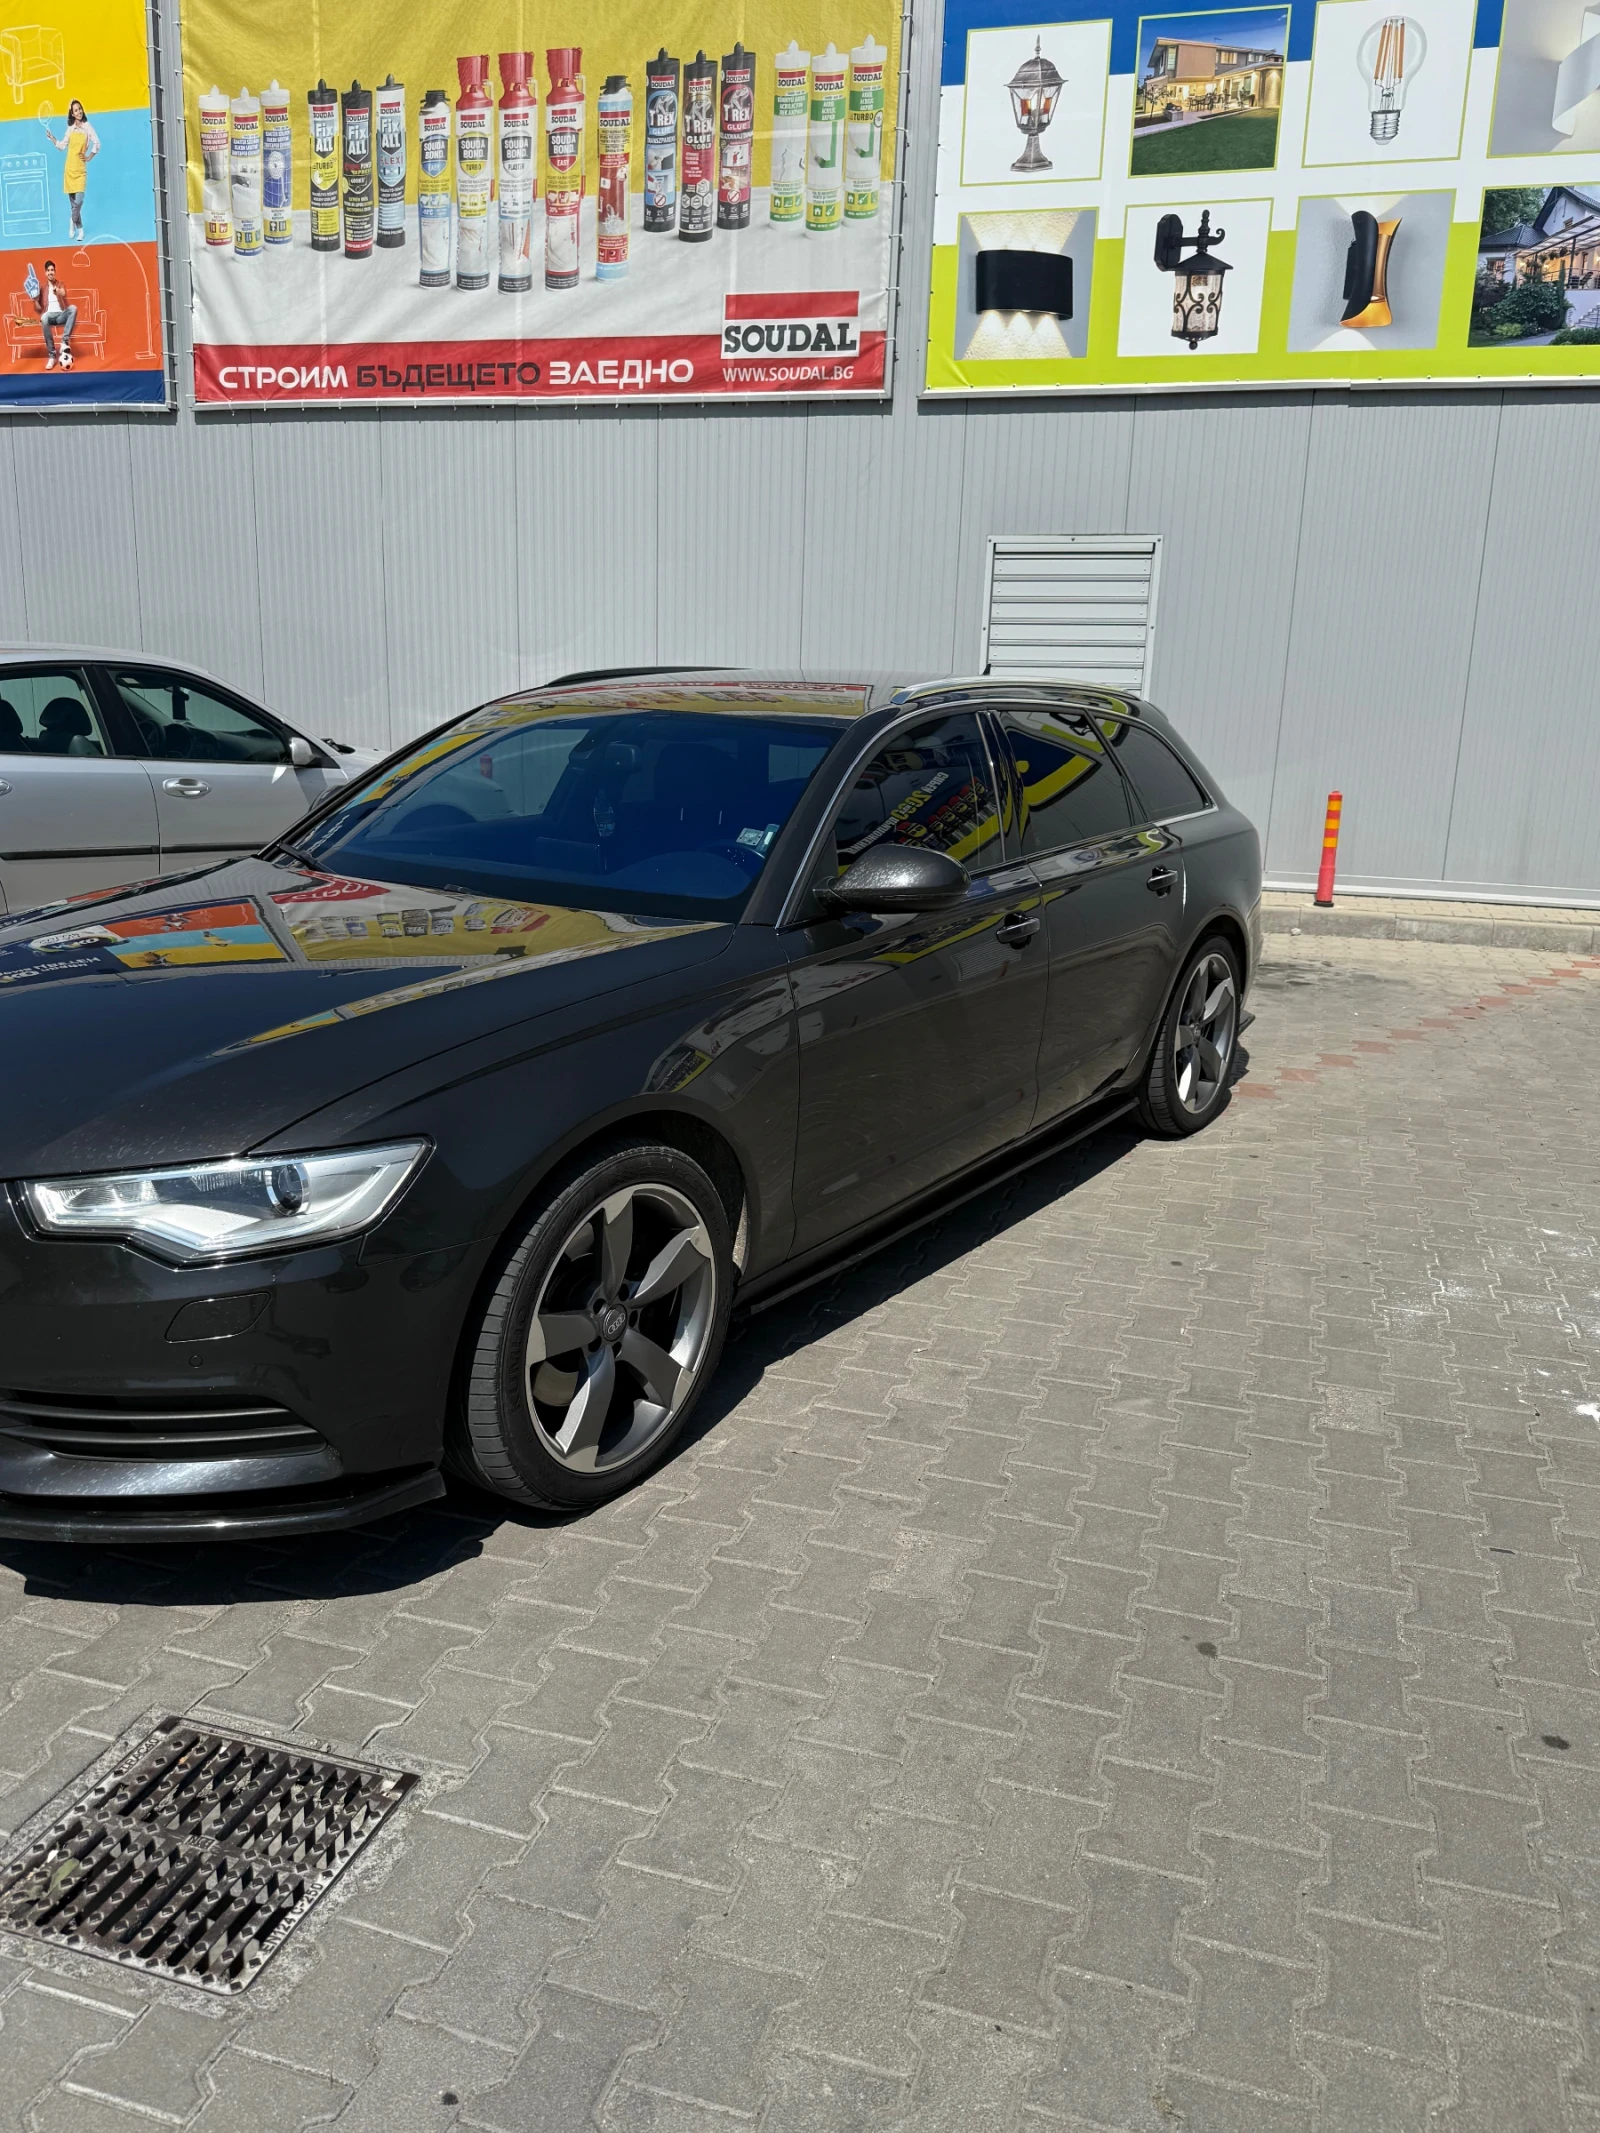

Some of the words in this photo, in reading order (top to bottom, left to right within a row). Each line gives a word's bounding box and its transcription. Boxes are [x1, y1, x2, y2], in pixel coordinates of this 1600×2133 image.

[853, 73, 882, 81] SOUDAL
[778, 78, 806, 87] SOUDAL
[815, 82, 844, 91] SOUDAL
[380, 106, 401, 115] SOUDAL
[724, 104, 731, 121] T
[732, 107, 750, 121] REX
[201, 117, 227, 125] SOUDAL
[265, 114, 289, 123] SOUDAL
[551, 115, 577, 124] SOUDAL
[649, 109, 656, 126] T
[657, 111, 675, 126] REX
[853, 113, 874, 121] TURBO
[234, 123, 259, 131] SOUDAL
[381, 118, 399, 133] Fix
[424, 123, 446, 132] SOUDAL
[460, 120, 485, 129] SOUDAL
[504, 120, 529, 128] SOUDAL
[600, 118, 630, 127] SOUDAL
[685, 115, 692, 133] T
[694, 118, 713, 133] REX
[727, 123, 747, 131] GLUE
[315, 122, 333, 137] Fix
[348, 125, 366, 140] Fix
[382, 133, 401, 148] ALL
[551, 133, 576, 145] SOUDA
[687, 134, 712, 143] GLUE
[315, 137, 334, 152] ALL
[348, 140, 367, 155] ALL
[424, 141, 445, 151] SOUDA
[461, 139, 486, 149] SOUDA
[505, 139, 529, 149] SOUDA
[428, 164, 440, 172] EASY
[723, 322, 857, 353] SOUDAL
[219, 365, 348, 389] СТРОИМ
[357, 361, 541, 392] БЪДЕЩЕТО
[550, 359, 694, 389] ЗАЕДНО
[722, 365, 855, 382] WWW.SOUDAL.BG
[261, 1917, 297, 1952] EN124
[291, 1882, 324, 1915] C-250
